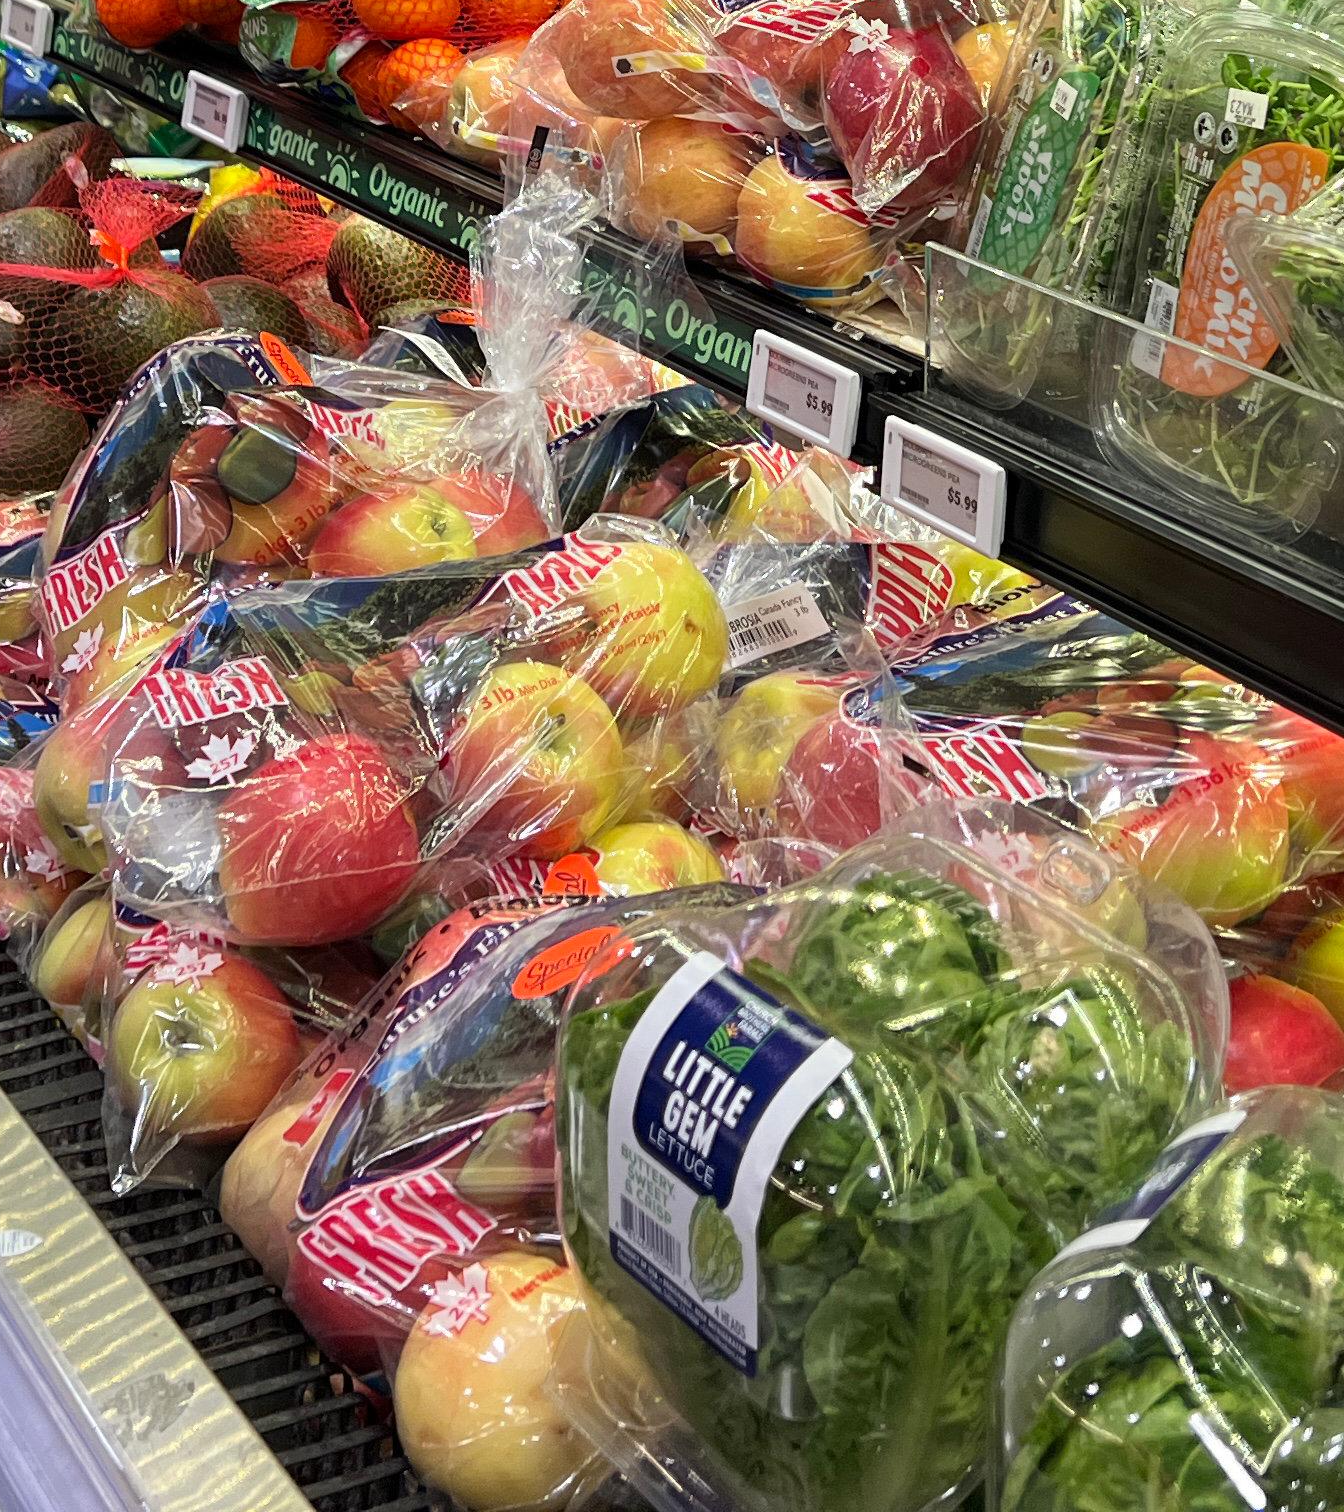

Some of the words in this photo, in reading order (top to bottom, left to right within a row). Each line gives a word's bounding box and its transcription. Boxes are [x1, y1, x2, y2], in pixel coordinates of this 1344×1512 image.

[80, 33, 133, 78] Organic
[368, 161, 450, 228] Organic
[1000, 113, 1047, 236] SHOOTS
[1016, 151, 1053, 225] PEA
[806, 393, 833, 418] $5.99
[807, 377, 819, 391] PEA
[947, 471, 961, 486] PEA
[293, 514, 305, 534] 3
[306, 504, 326, 524] lb
[948, 487, 979, 514] $5.99
[39, 532, 130, 638] FRESH
[504, 532, 624, 618] APPLES
[758, 603, 781, 617] Canada
[781, 595, 805, 610] Fancy
[800, 606, 810, 617] lb
[142, 656, 289, 729] FRESH
[480, 694, 493, 711] 3
[494, 680, 515, 704] lb
[518, 682, 539, 697] Min
[209, 752, 241, 774] 257
[1178, 768, 1225, 801] 1.36
[525, 932, 612, 993] Special
[661, 1039, 755, 1131] LITTLE
[662, 1089, 721, 1160] GEM
[648, 1121, 716, 1189] LETTUCE
[624, 1163, 670, 1208] SWEET
[634, 1184, 673, 1226] CRISP
[297, 1168, 500, 1306] FRESH
[450, 1286, 480, 1321] 257
[713, 1302, 721, 1317] 4
[721, 1305, 747, 1340] HEADS
